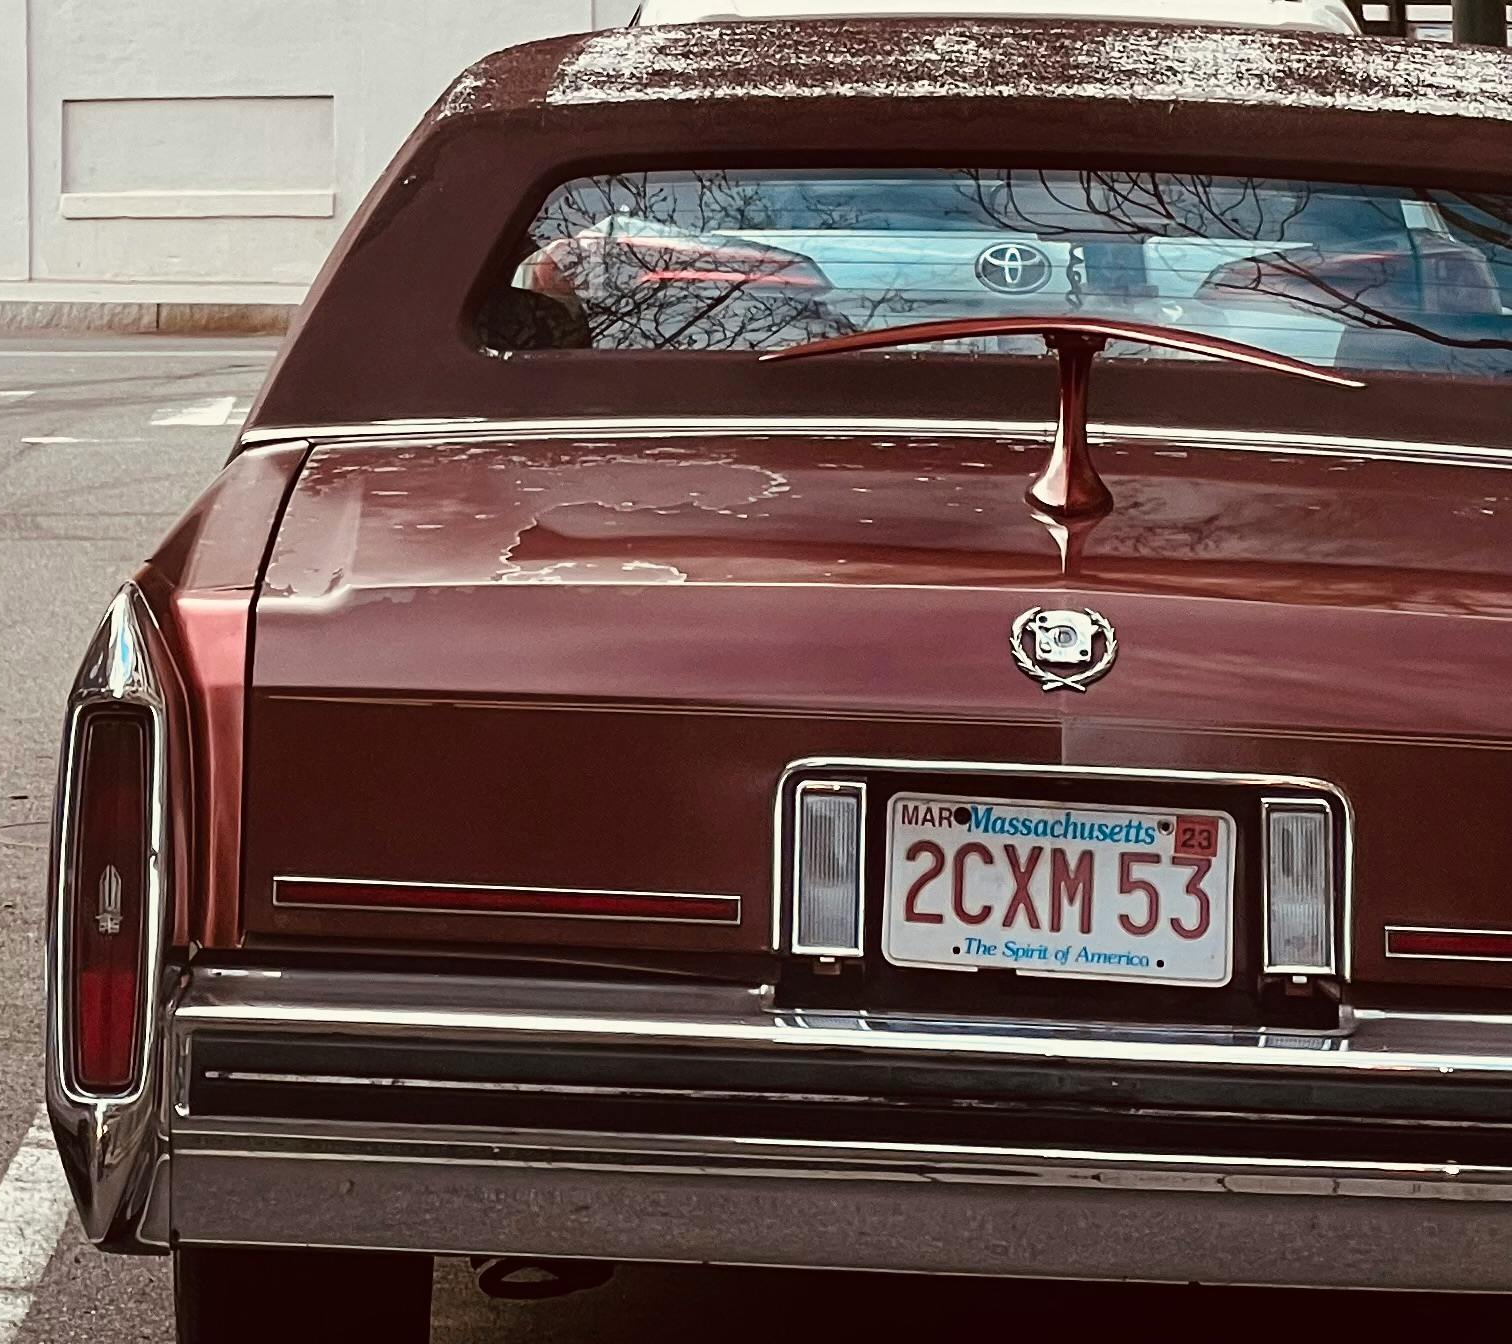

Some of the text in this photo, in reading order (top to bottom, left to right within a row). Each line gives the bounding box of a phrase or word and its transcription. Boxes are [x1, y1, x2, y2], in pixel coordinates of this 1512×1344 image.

[901, 804, 953, 829] MAR
[967, 805, 1156, 846] Massachusetts
[1181, 827, 1212, 850] 23
[904, 839, 1213, 940] 2CXM 53
[964, 937, 1150, 967] The Spirit of America
